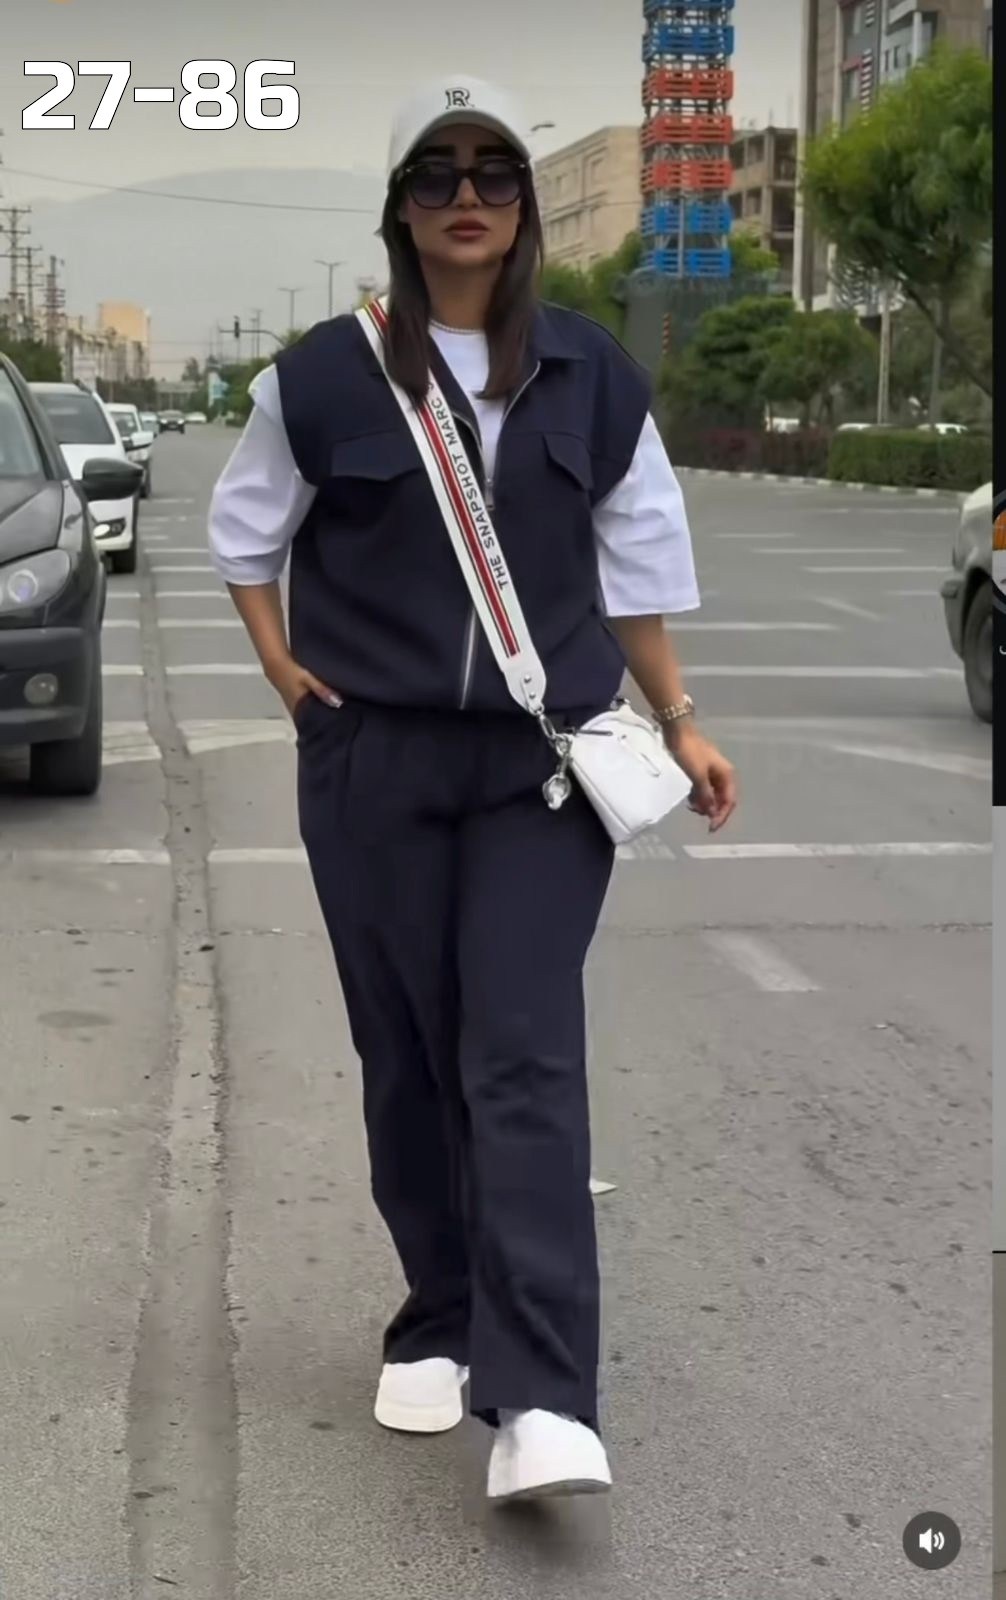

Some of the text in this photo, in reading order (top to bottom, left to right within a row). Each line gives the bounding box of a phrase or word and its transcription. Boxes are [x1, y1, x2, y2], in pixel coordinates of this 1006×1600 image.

[431, 397, 509, 590] THE SNAPSHOT MARC
